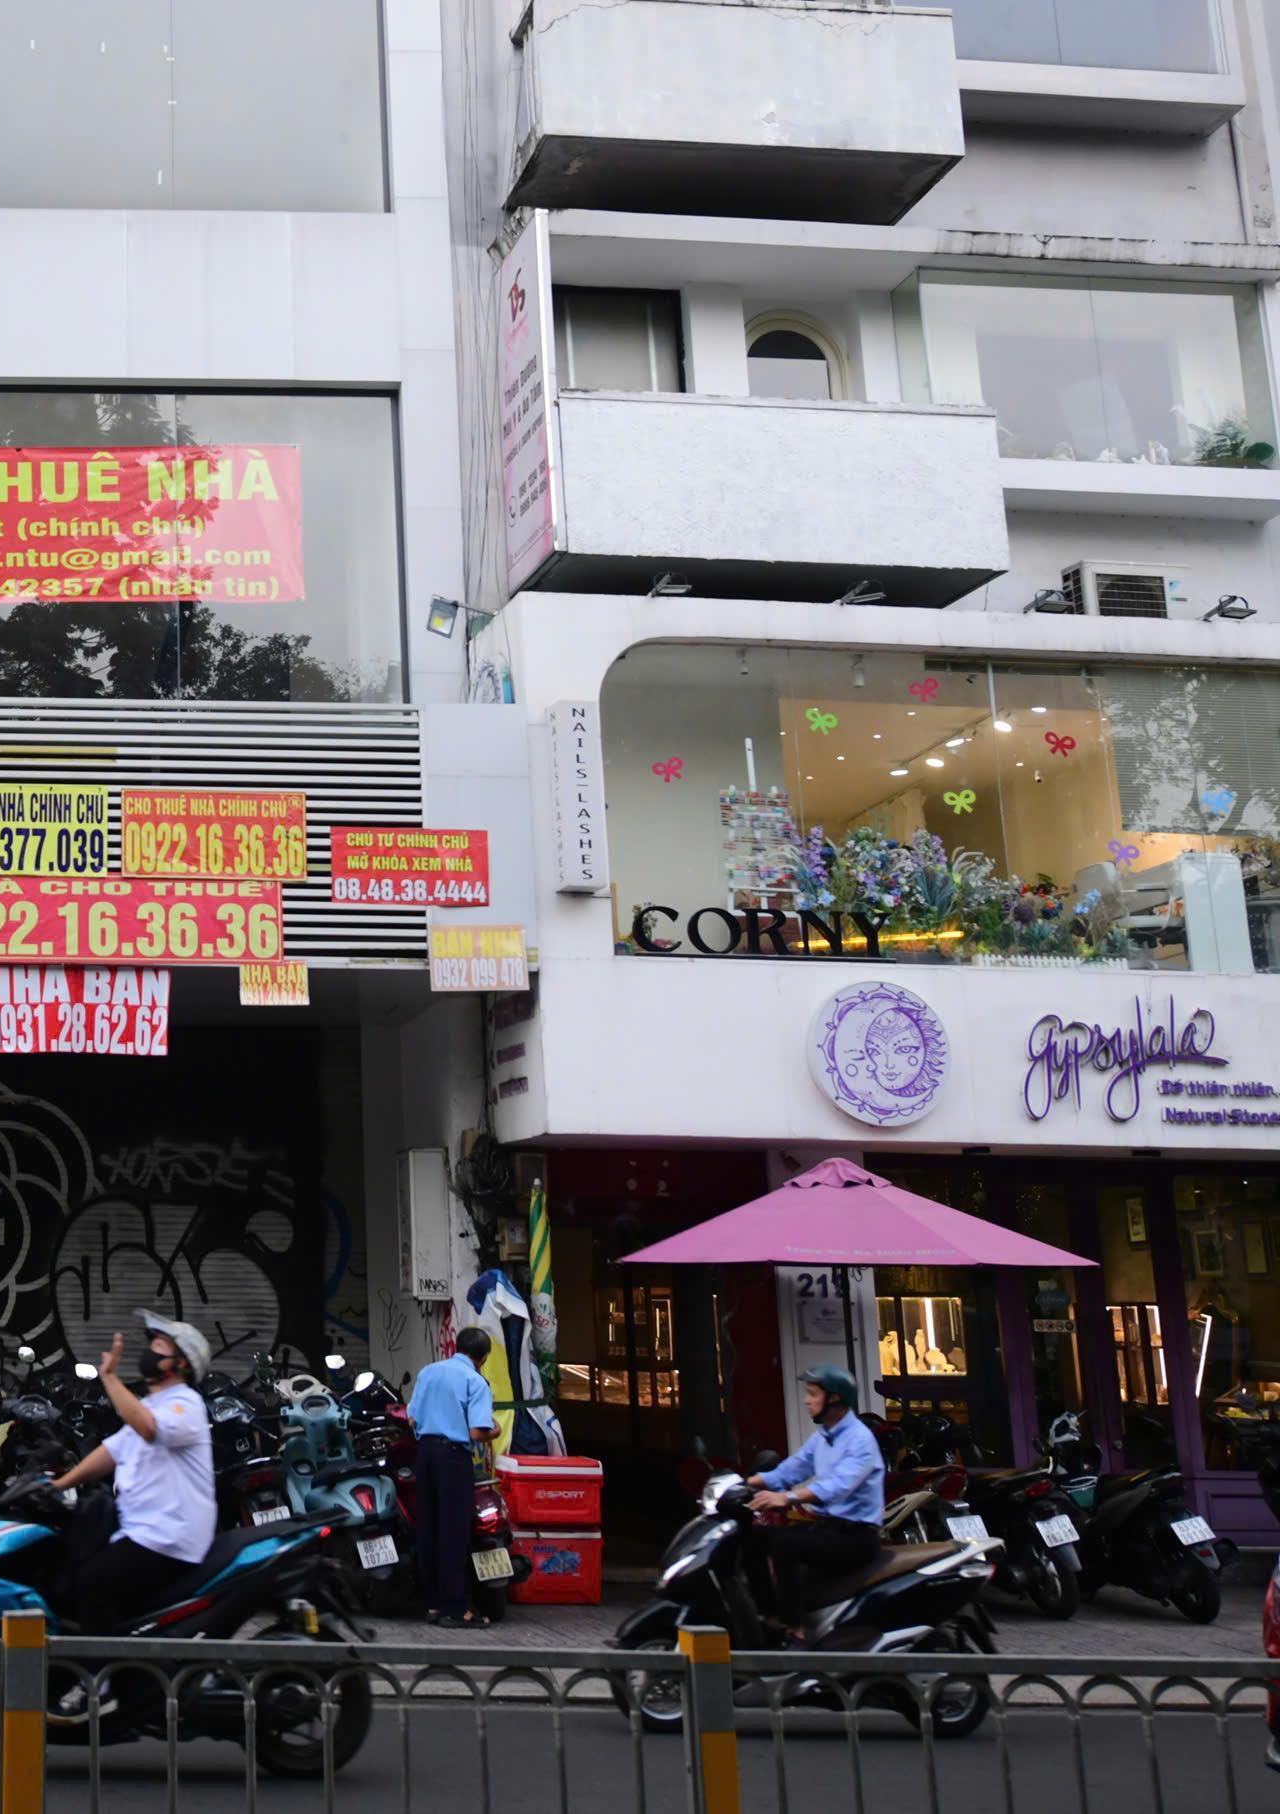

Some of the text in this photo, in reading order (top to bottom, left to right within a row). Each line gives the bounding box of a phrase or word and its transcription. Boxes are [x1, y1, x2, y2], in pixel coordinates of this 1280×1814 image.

[147, 450, 278, 502] NHÀ
[17, 517, 120, 539] (chính
[132, 514, 205, 539] chủ)
[224, 576, 279, 600] tin)
[30, 786, 71, 823] CHÍNH
[77, 787, 104, 824] CHỦ
[126, 794, 287, 817] CHO THUÊ NHÀ CHÍNH CHỦ
[126, 821, 304, 875] 0922.16.36.36
[377, 832, 394, 847] TƯ
[397, 832, 438, 848] CHÍNH
[412, 856, 441, 871] XEM
[40, 881, 132, 895] CHO
[149, 880, 263, 897] THUÊ
[334, 877, 486, 903] 08.48.38.4444
[632, 905, 893, 959] CORNY
[434, 958, 467, 987] 0932
[471, 958, 496, 986] 099
[1163, 1107, 1226, 1124] Natural
[797, 1273, 845, 1298] 21
